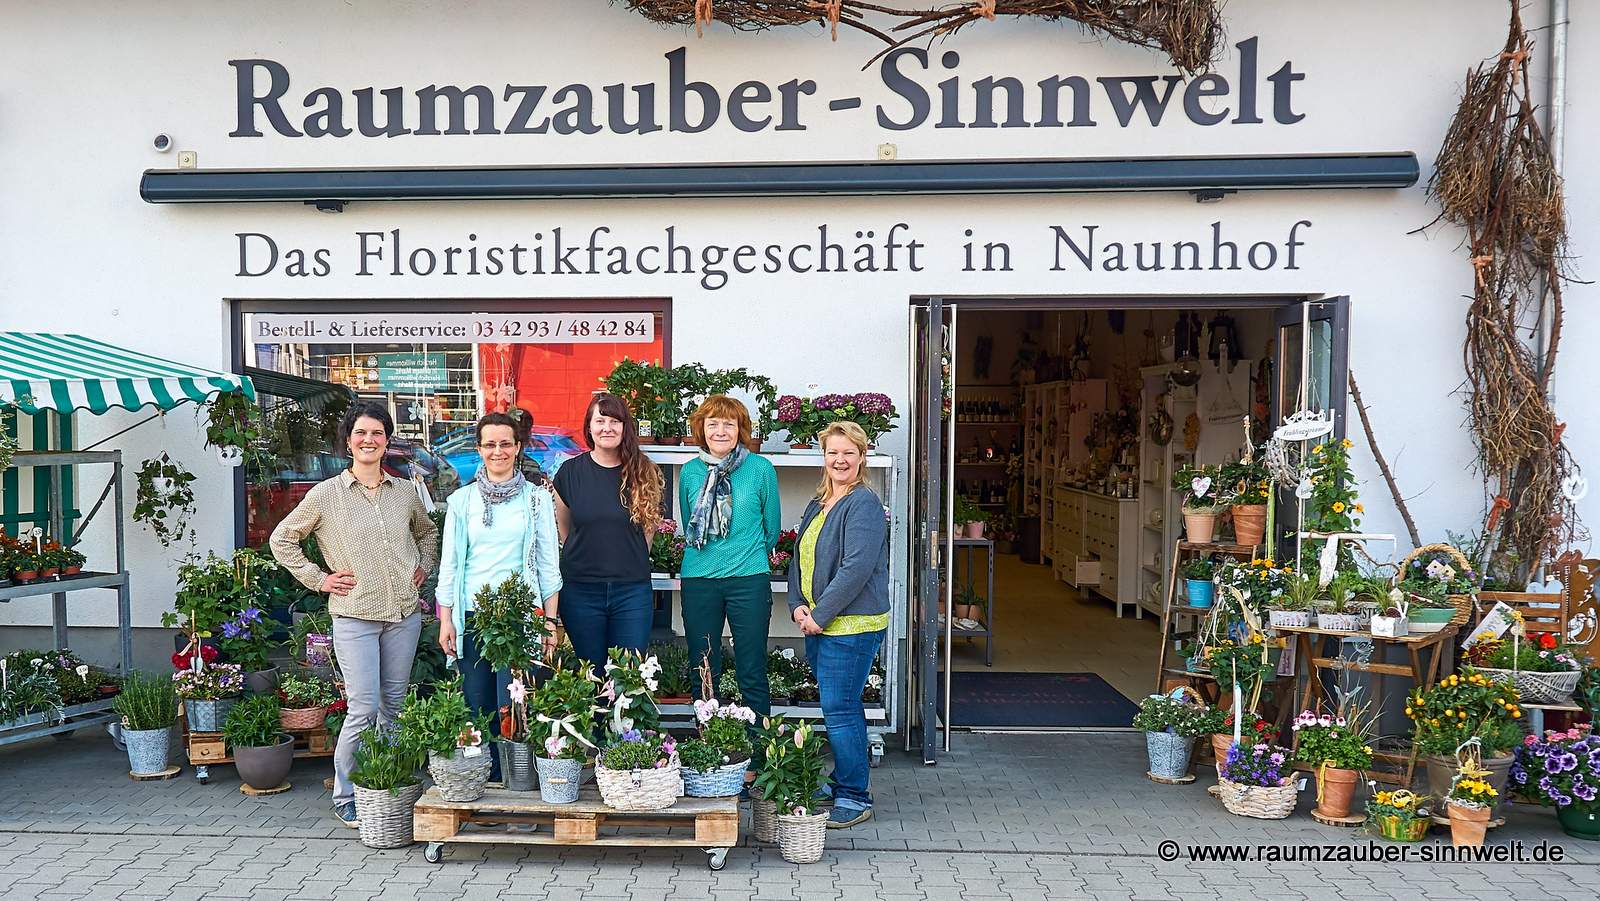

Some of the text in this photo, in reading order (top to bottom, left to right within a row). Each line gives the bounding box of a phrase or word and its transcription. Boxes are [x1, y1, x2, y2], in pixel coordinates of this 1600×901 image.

[235, 220, 1312, 291] Das Floristikfachgeschäft in Naunhof
[258, 320, 323, 337] Bestell-
[328, 321, 345, 337] &
[351, 319, 466, 337] Lieferservice:
[499, 319, 522, 337] 42
[527, 320, 550, 338] 93
[555, 319, 563, 337] /
[568, 319, 590, 337] 48
[596, 319, 618, 337] 42
[624, 319, 647, 337] 84
